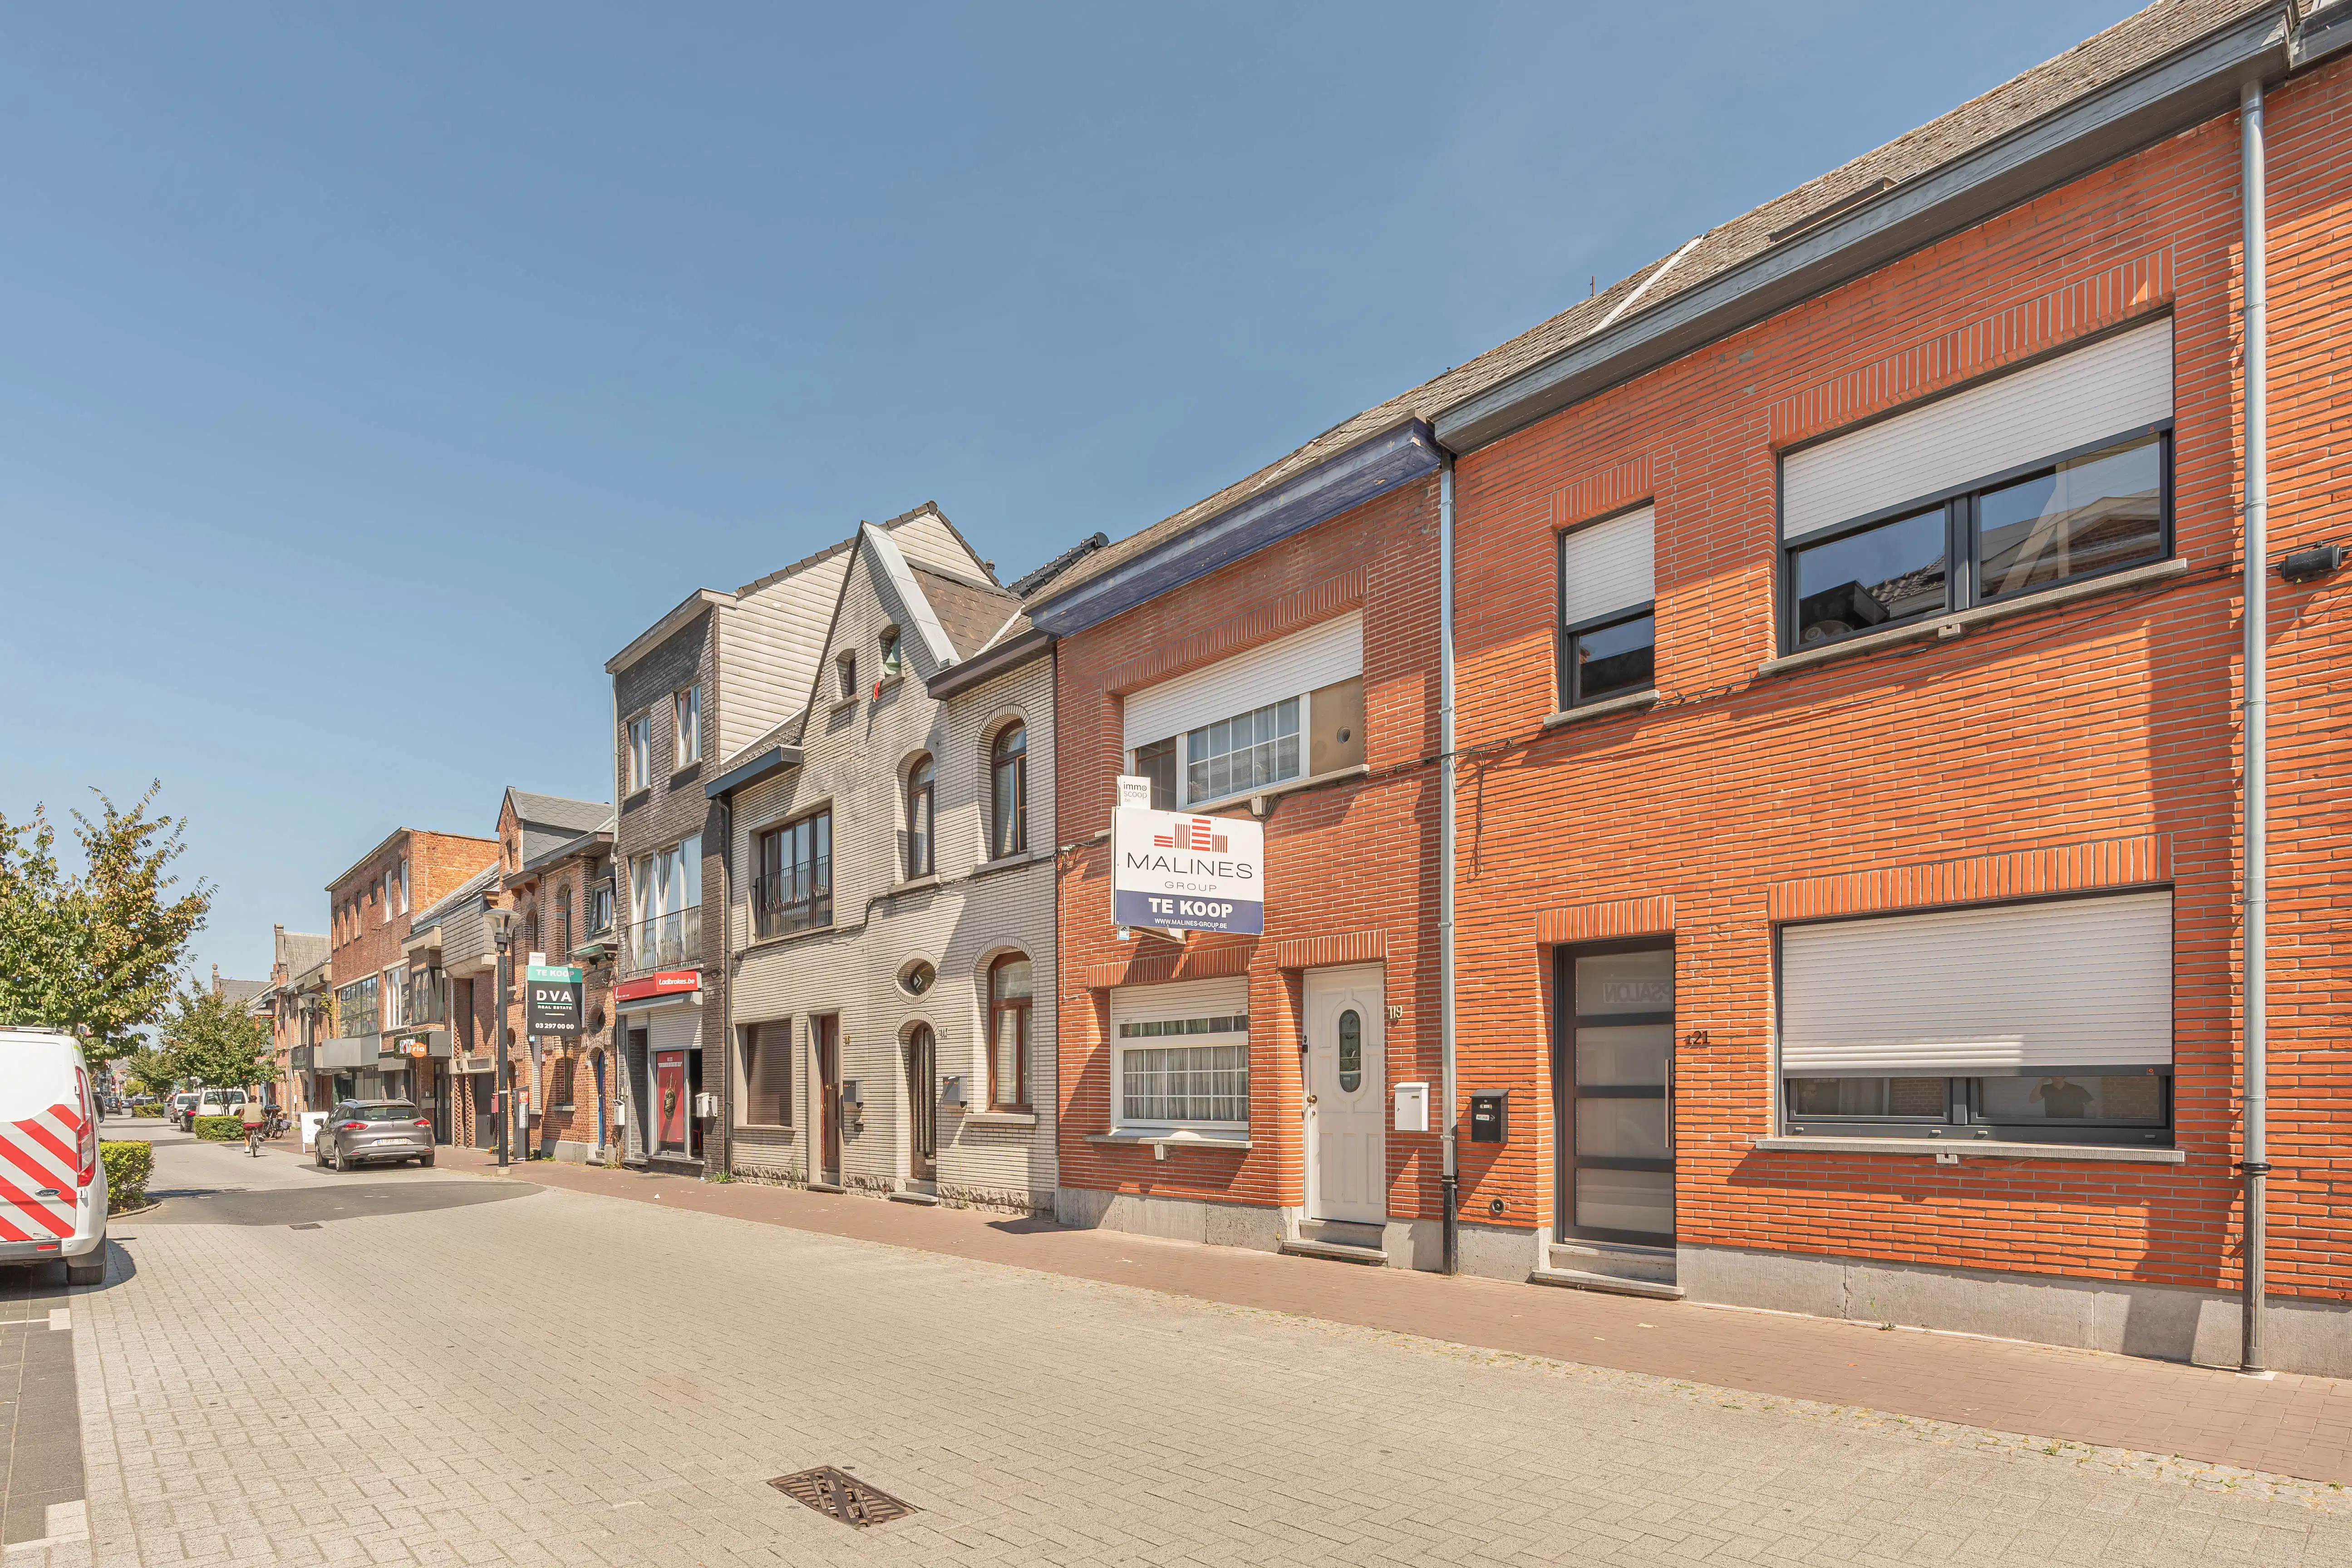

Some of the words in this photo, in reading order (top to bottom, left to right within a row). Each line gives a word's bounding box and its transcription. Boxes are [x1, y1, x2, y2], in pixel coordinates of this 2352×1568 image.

[1123, 782, 1147, 791] immo
[1124, 791, 1147, 800] scoop
[1127, 852, 1252, 879] MALINES
[1165, 881, 1217, 892] GROUP
[1148, 897, 1174, 914] TE
[1180, 900, 1233, 918] KOOP
[1154, 918, 1228, 929] WWW.MALINES-GROUP.BE
[536, 989, 572, 1002] DVA
[1684, 1030, 1711, 1044] 121
